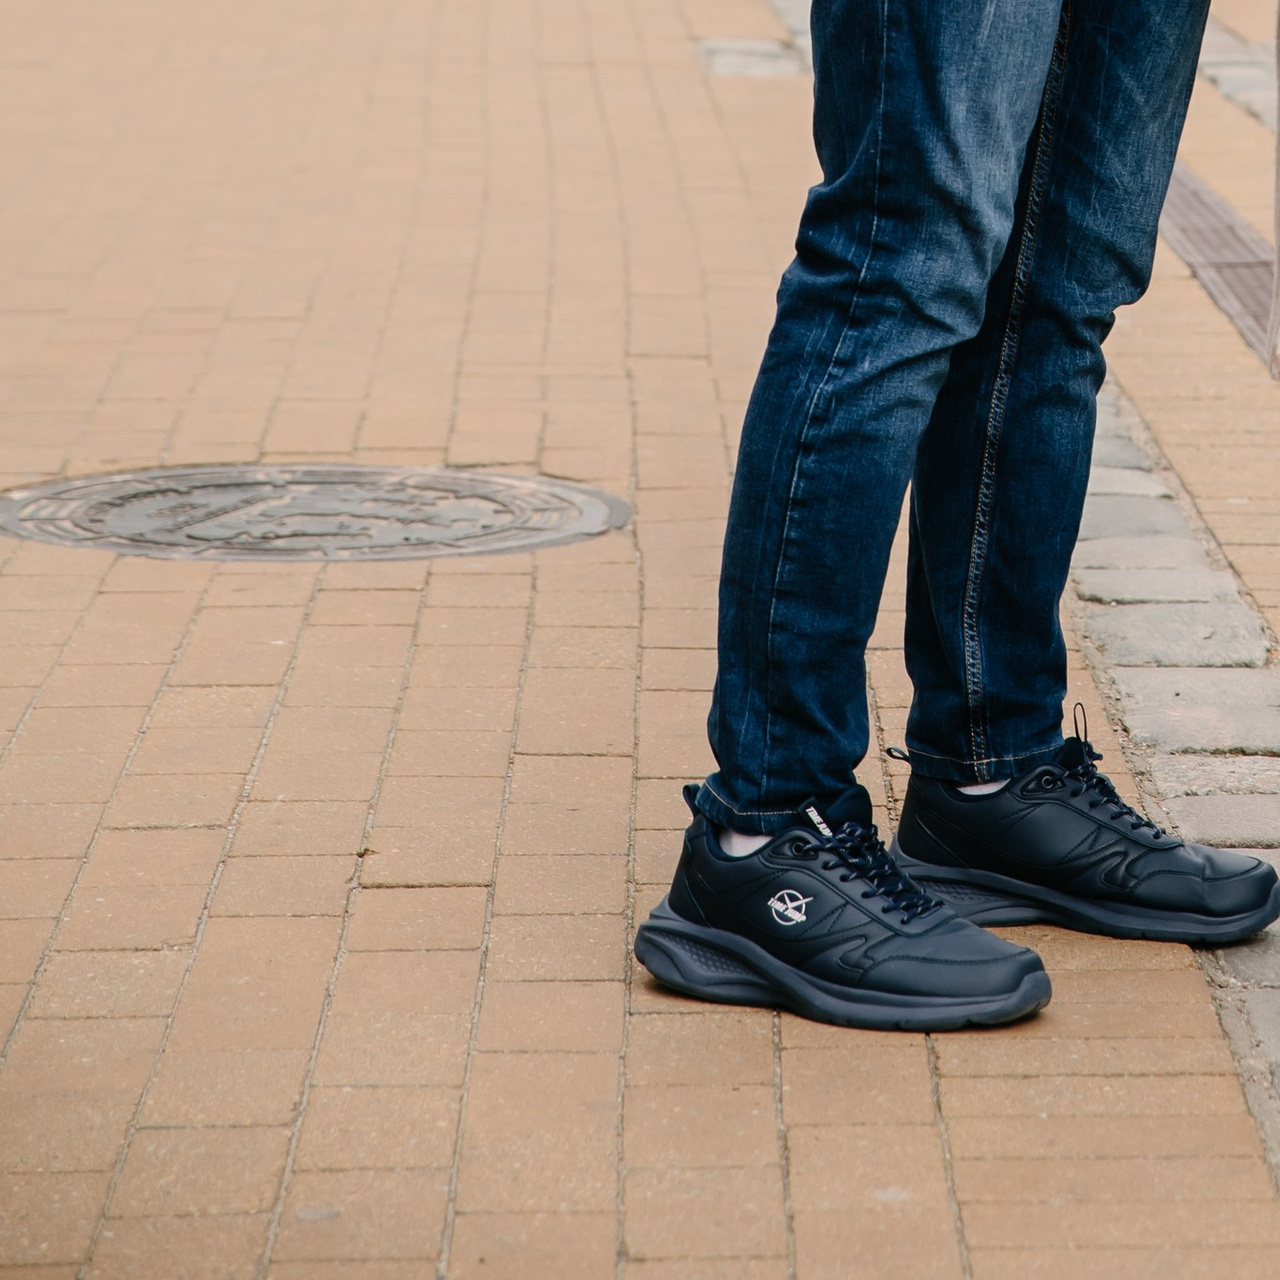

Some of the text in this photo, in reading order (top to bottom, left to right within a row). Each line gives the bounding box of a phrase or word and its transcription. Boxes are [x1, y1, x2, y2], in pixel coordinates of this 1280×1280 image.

[805, 805, 824, 828] TIME
[767, 897, 807, 923] TIME JUMP
